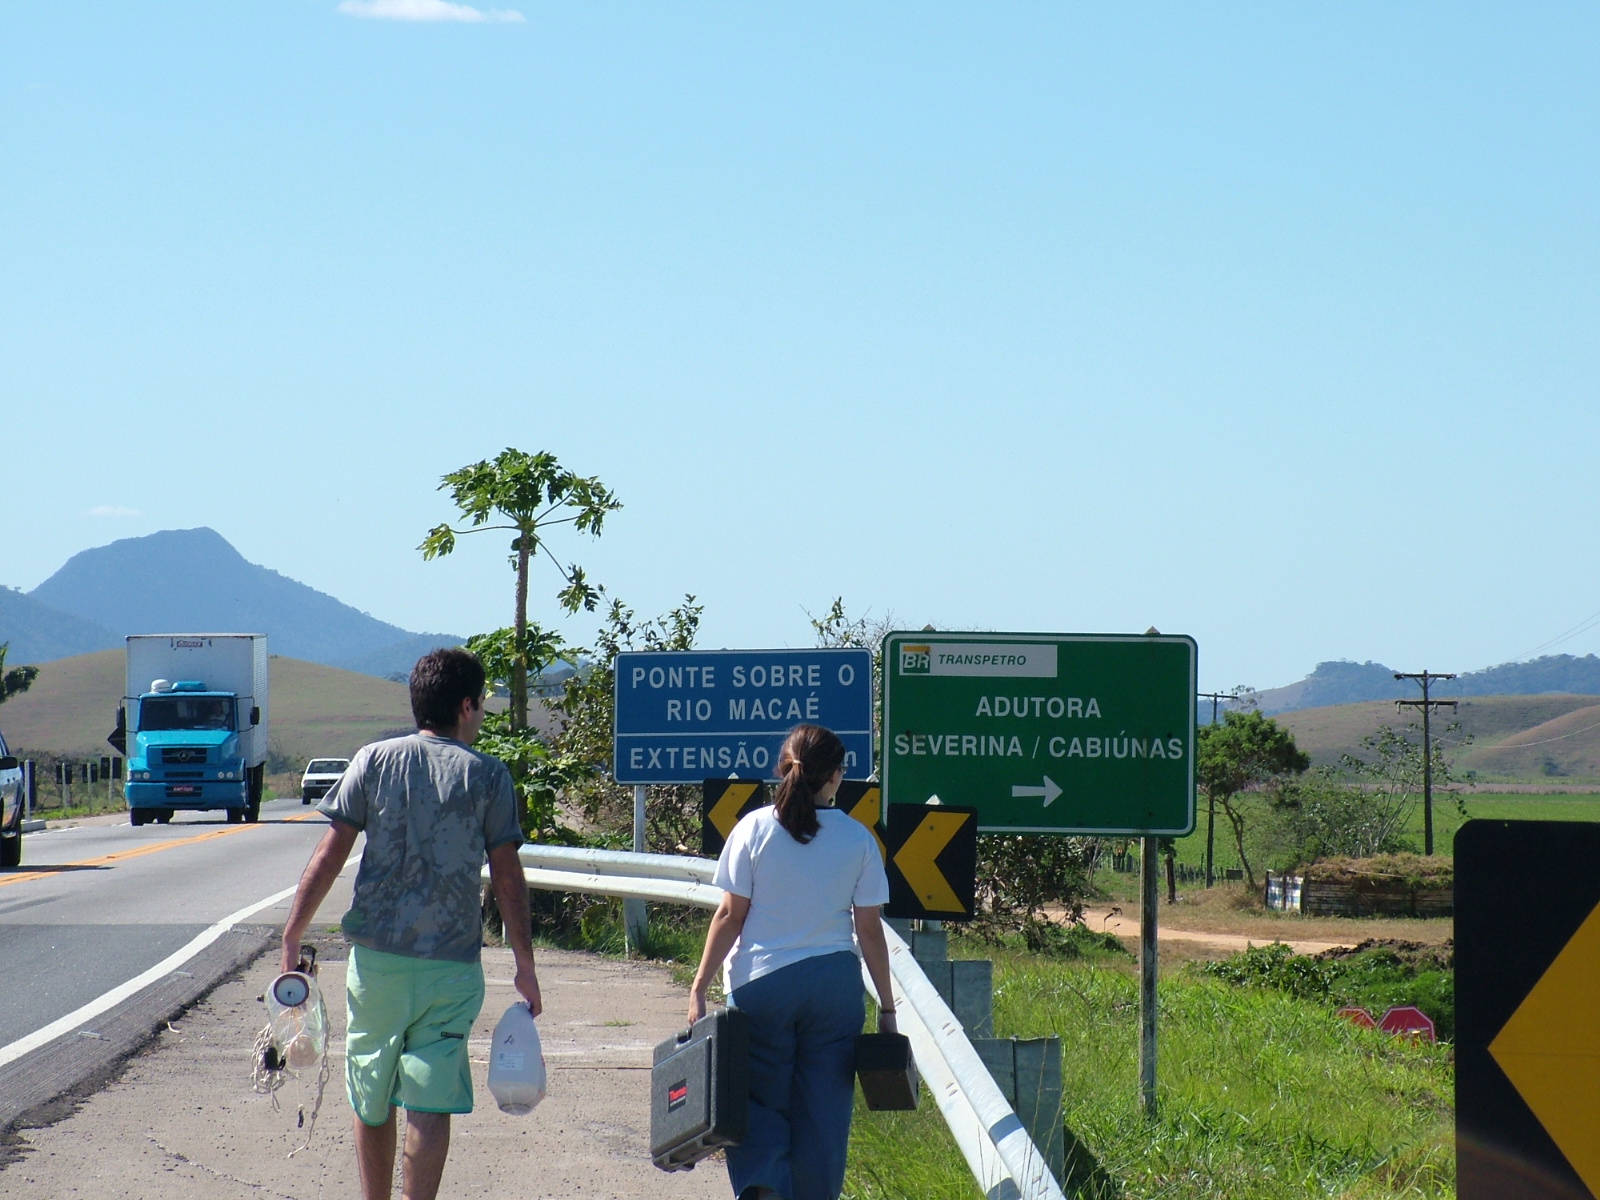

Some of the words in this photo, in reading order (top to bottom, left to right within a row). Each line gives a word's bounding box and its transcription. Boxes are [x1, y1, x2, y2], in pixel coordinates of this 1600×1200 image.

[903, 653, 929, 668] BR
[938, 653, 1027, 666] TRANSPETRO
[632, 666, 715, 689] PONTE
[732, 665, 821, 687] SOBRE
[837, 664, 855, 686] O
[667, 699, 712, 721] RIO
[728, 691, 819, 720] MACAÉ
[975, 696, 1102, 718] ADUTORA
[629, 741, 769, 768] EXTENSÃO
[894, 734, 1023, 756] SEVERINA
[1049, 730, 1184, 759] CABIÚNAS
